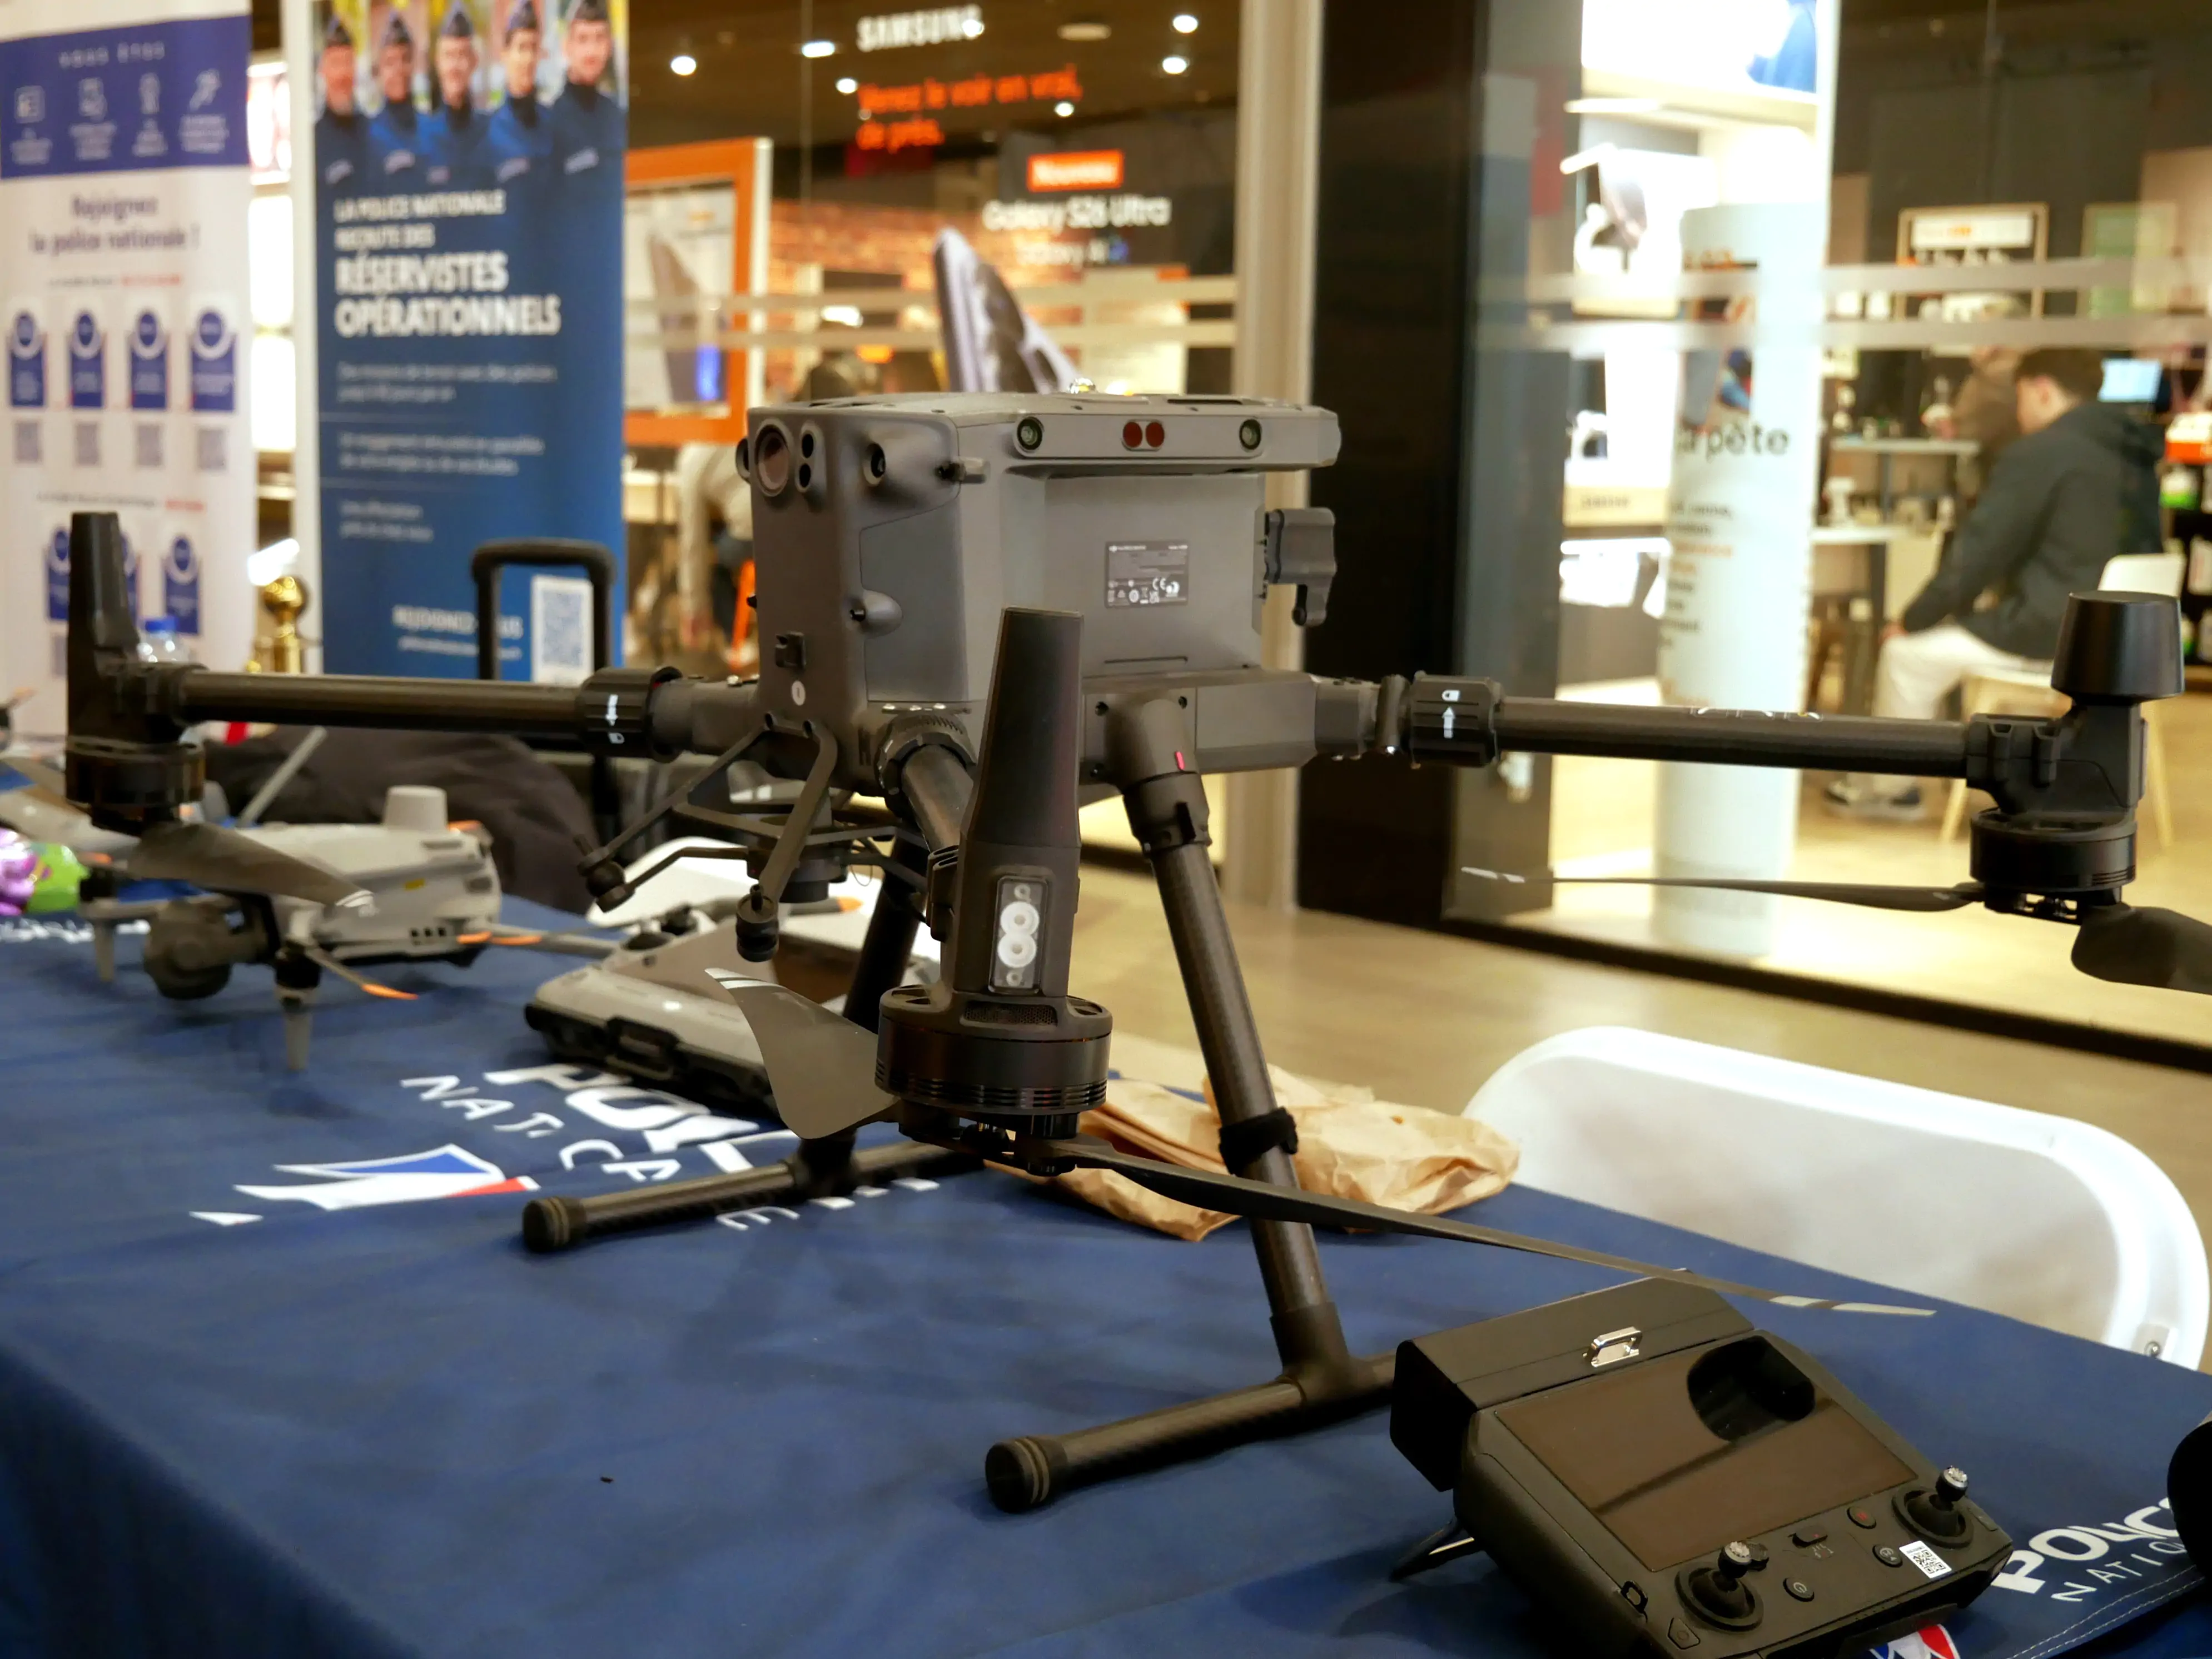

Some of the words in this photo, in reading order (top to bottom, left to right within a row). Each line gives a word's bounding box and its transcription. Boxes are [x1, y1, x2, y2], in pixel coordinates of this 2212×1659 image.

[857, 4, 982, 51] SAMSUNG
[336, 250, 509, 295] RÉSERVISTES
[335, 291, 561, 337] OPÉRATIONNELS
[1990, 1497, 2181, 1594] POLIC
